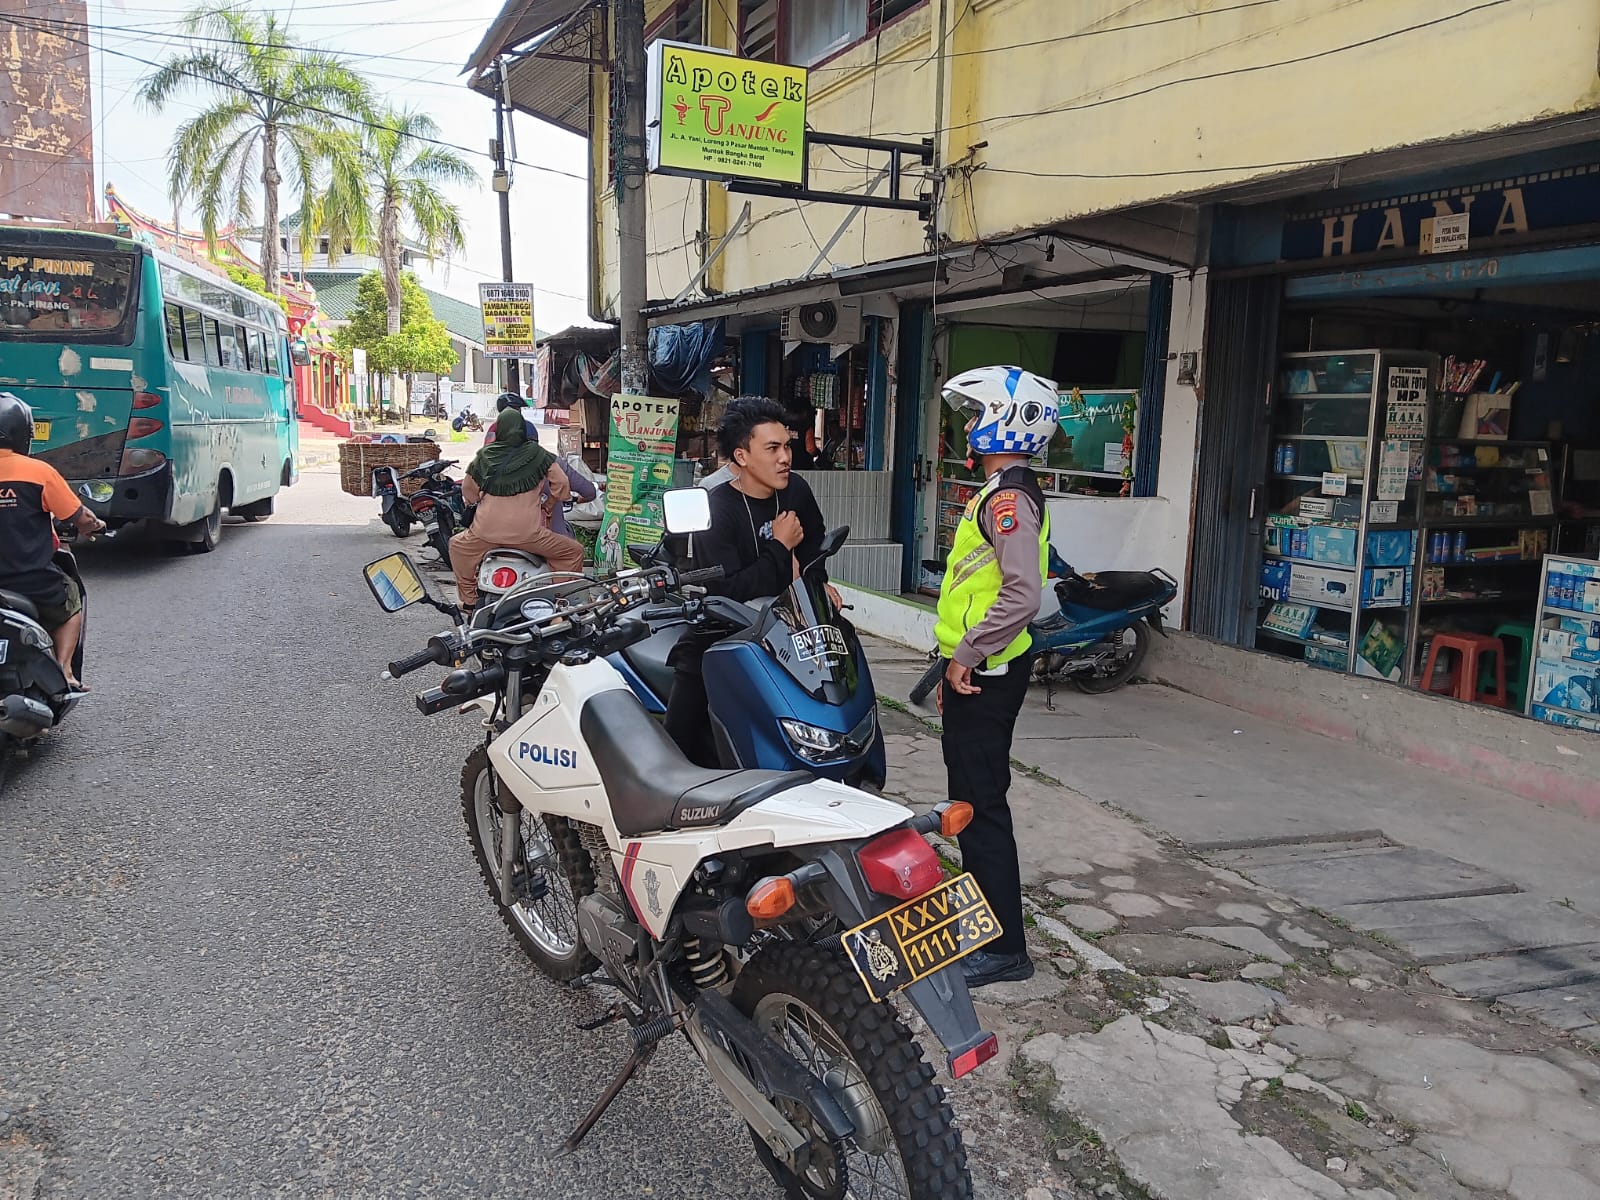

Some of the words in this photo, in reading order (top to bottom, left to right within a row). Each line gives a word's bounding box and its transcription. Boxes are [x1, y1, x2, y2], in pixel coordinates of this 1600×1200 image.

[666, 55, 802, 102] Apotek
[703, 138, 725, 147] Lorong
[730, 141, 747, 149] Pasar
[1412, 376, 1426, 390] FOTO
[1396, 390, 1420, 401] HP
[612, 400, 677, 415] APOTEK
[626, 412, 674, 437] TANJUNG
[1388, 412, 1423, 422] HANA
[36, 424, 46, 434] RU
[795, 632, 812, 650] BN
[519, 742, 577, 768] POLISI
[680, 806, 720, 821] SUZUKI
[910, 909, 994, 968] 1111-35
